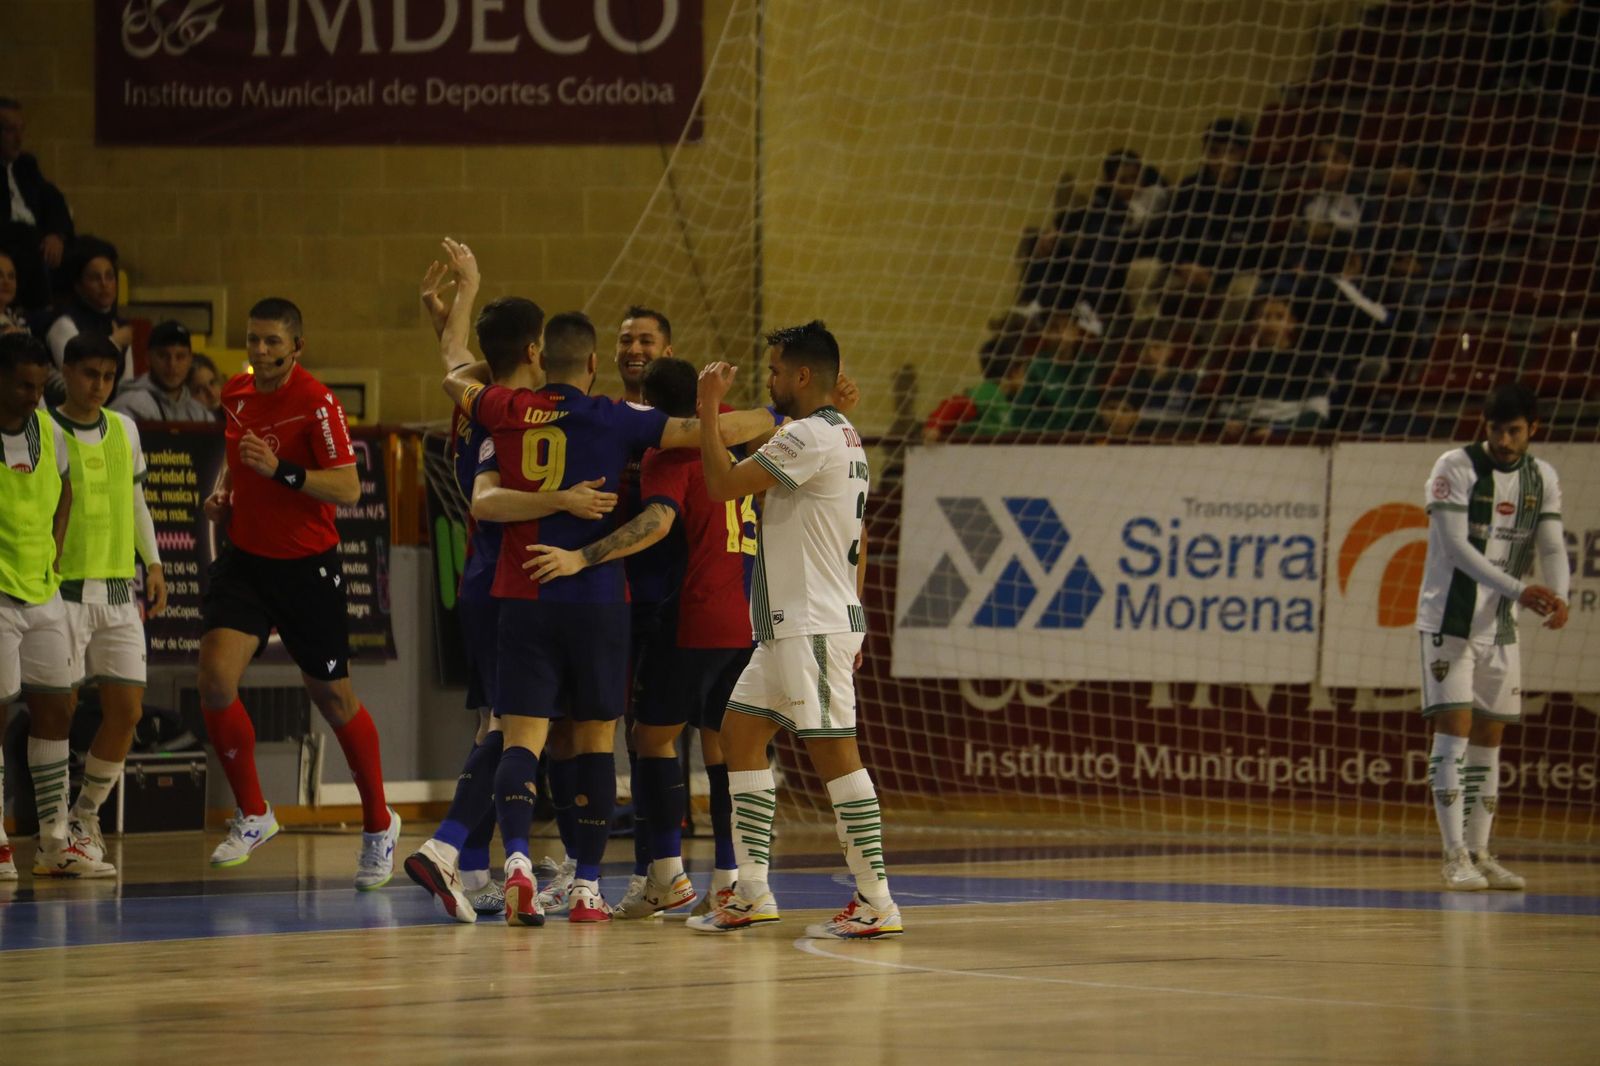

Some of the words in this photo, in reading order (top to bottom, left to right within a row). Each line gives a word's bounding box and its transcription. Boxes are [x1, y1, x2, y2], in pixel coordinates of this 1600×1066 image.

[124, 79, 232, 107] Instituto
[242, 78, 374, 113] Municipal
[383, 78, 417, 104] de
[427, 77, 550, 112] Deportes
[558, 76, 675, 105] Córdoba
[186, 467, 197, 485] de
[522, 424, 567, 492] 9
[1182, 497, 1321, 521] Transportes
[1118, 516, 1319, 580] Sierra
[1114, 582, 1315, 632] Morena
[963, 741, 1121, 779] Instituto
[1132, 744, 1328, 792] Municipal
[1340, 749, 1393, 785] de
[1404, 749, 1597, 791] Dortes
